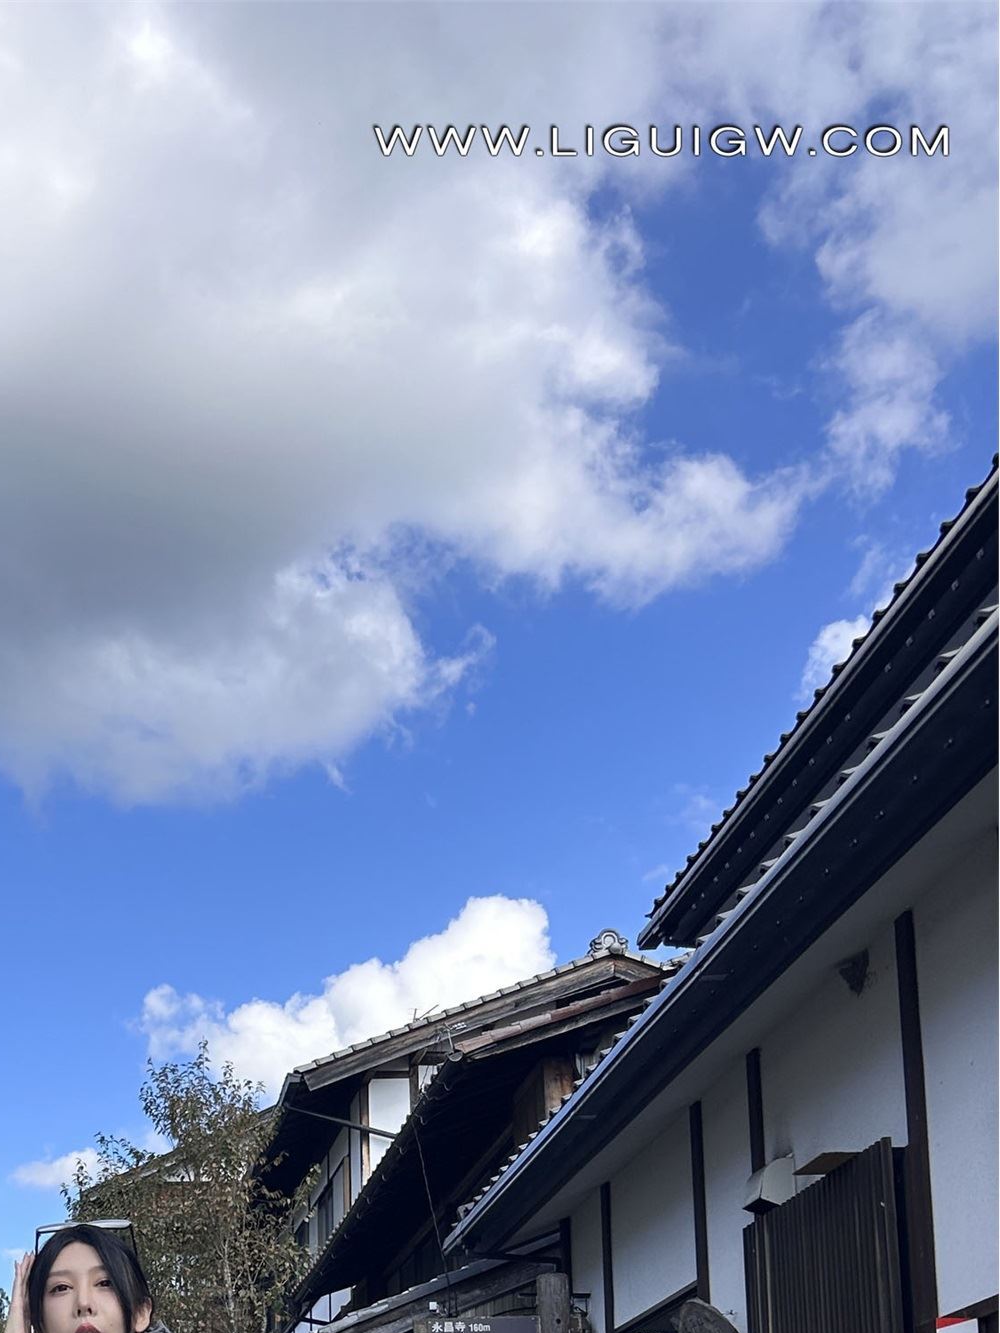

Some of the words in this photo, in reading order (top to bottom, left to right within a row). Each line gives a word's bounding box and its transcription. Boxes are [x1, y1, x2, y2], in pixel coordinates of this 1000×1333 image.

[432, 1322, 465, 1332] 永昌寺
[468, 1323, 491, 1332] 160m
